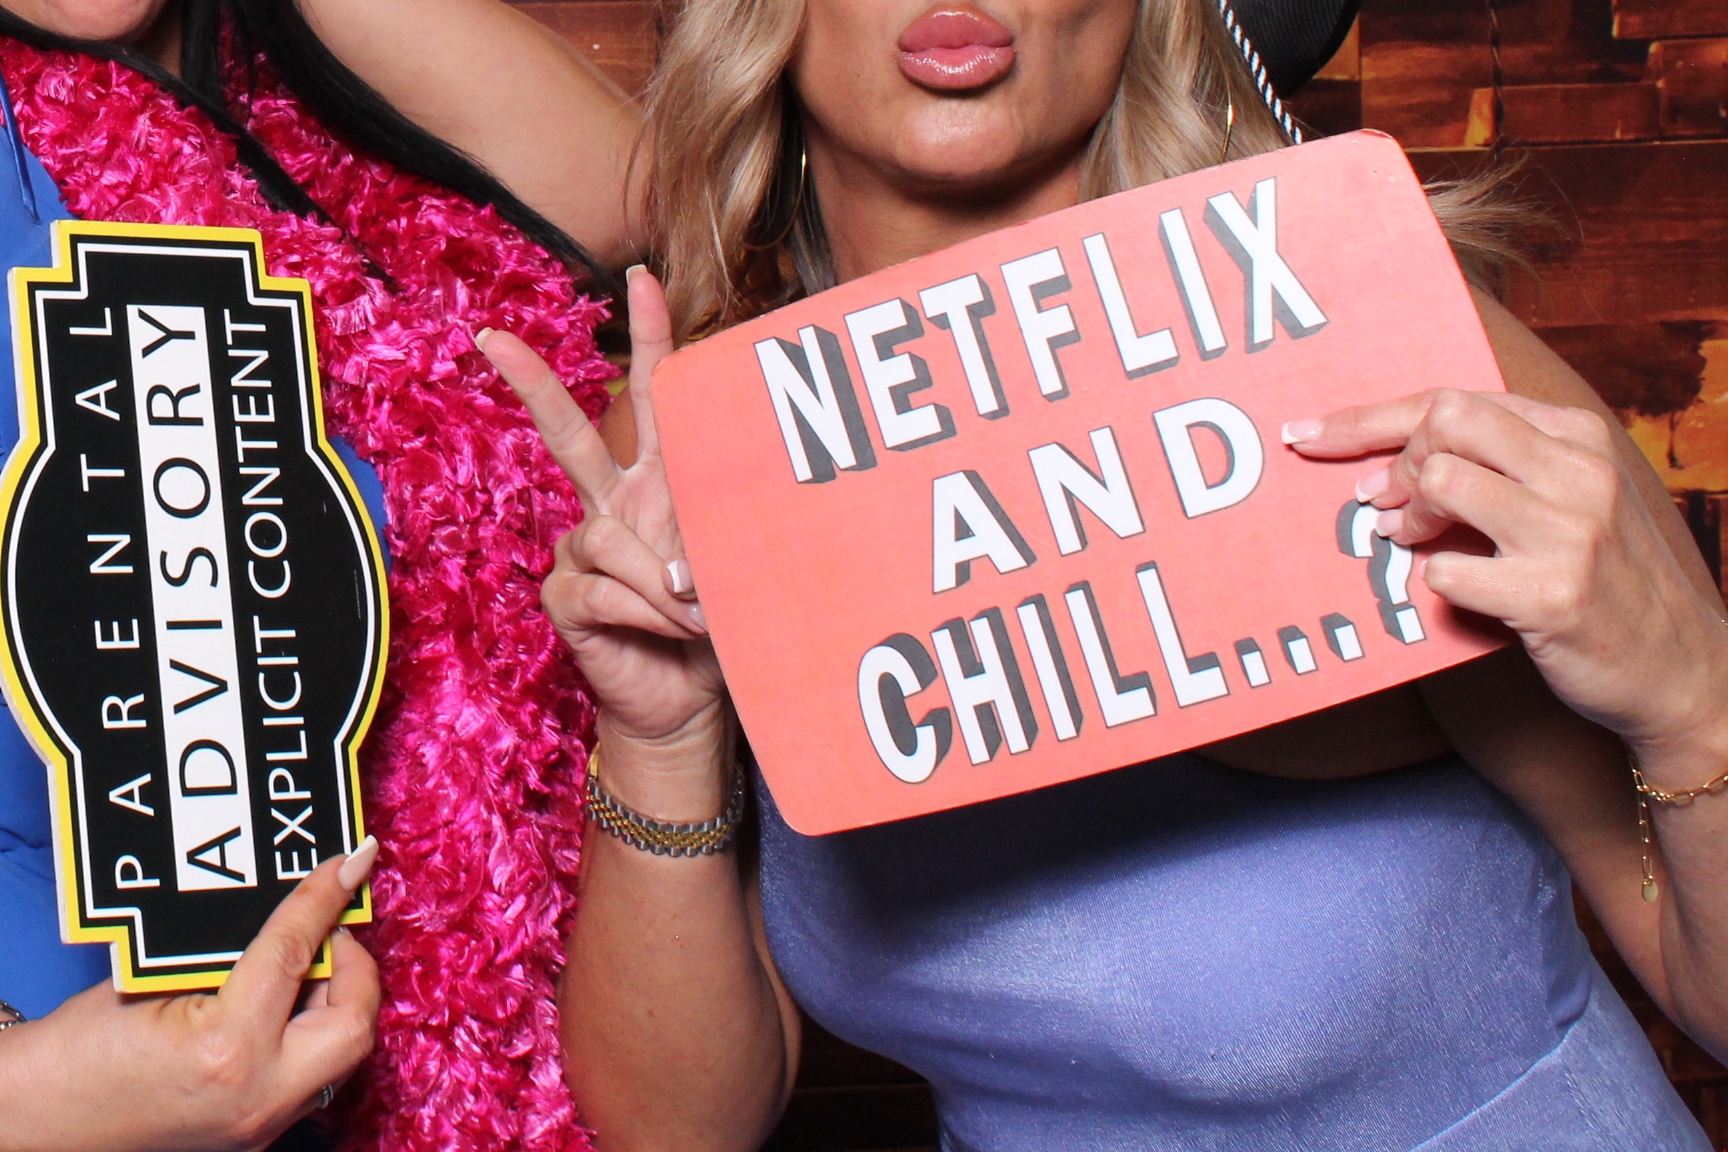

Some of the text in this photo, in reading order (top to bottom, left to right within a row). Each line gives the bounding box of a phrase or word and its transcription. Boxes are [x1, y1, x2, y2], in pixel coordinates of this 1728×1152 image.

[69, 307, 161, 889] PARENTAL
[137, 309, 247, 884] ADVISORY
[223, 307, 319, 880] EXPLICIT CONTENT
[753, 176, 1330, 485] NETFLIX
[931, 397, 1265, 594] AND
